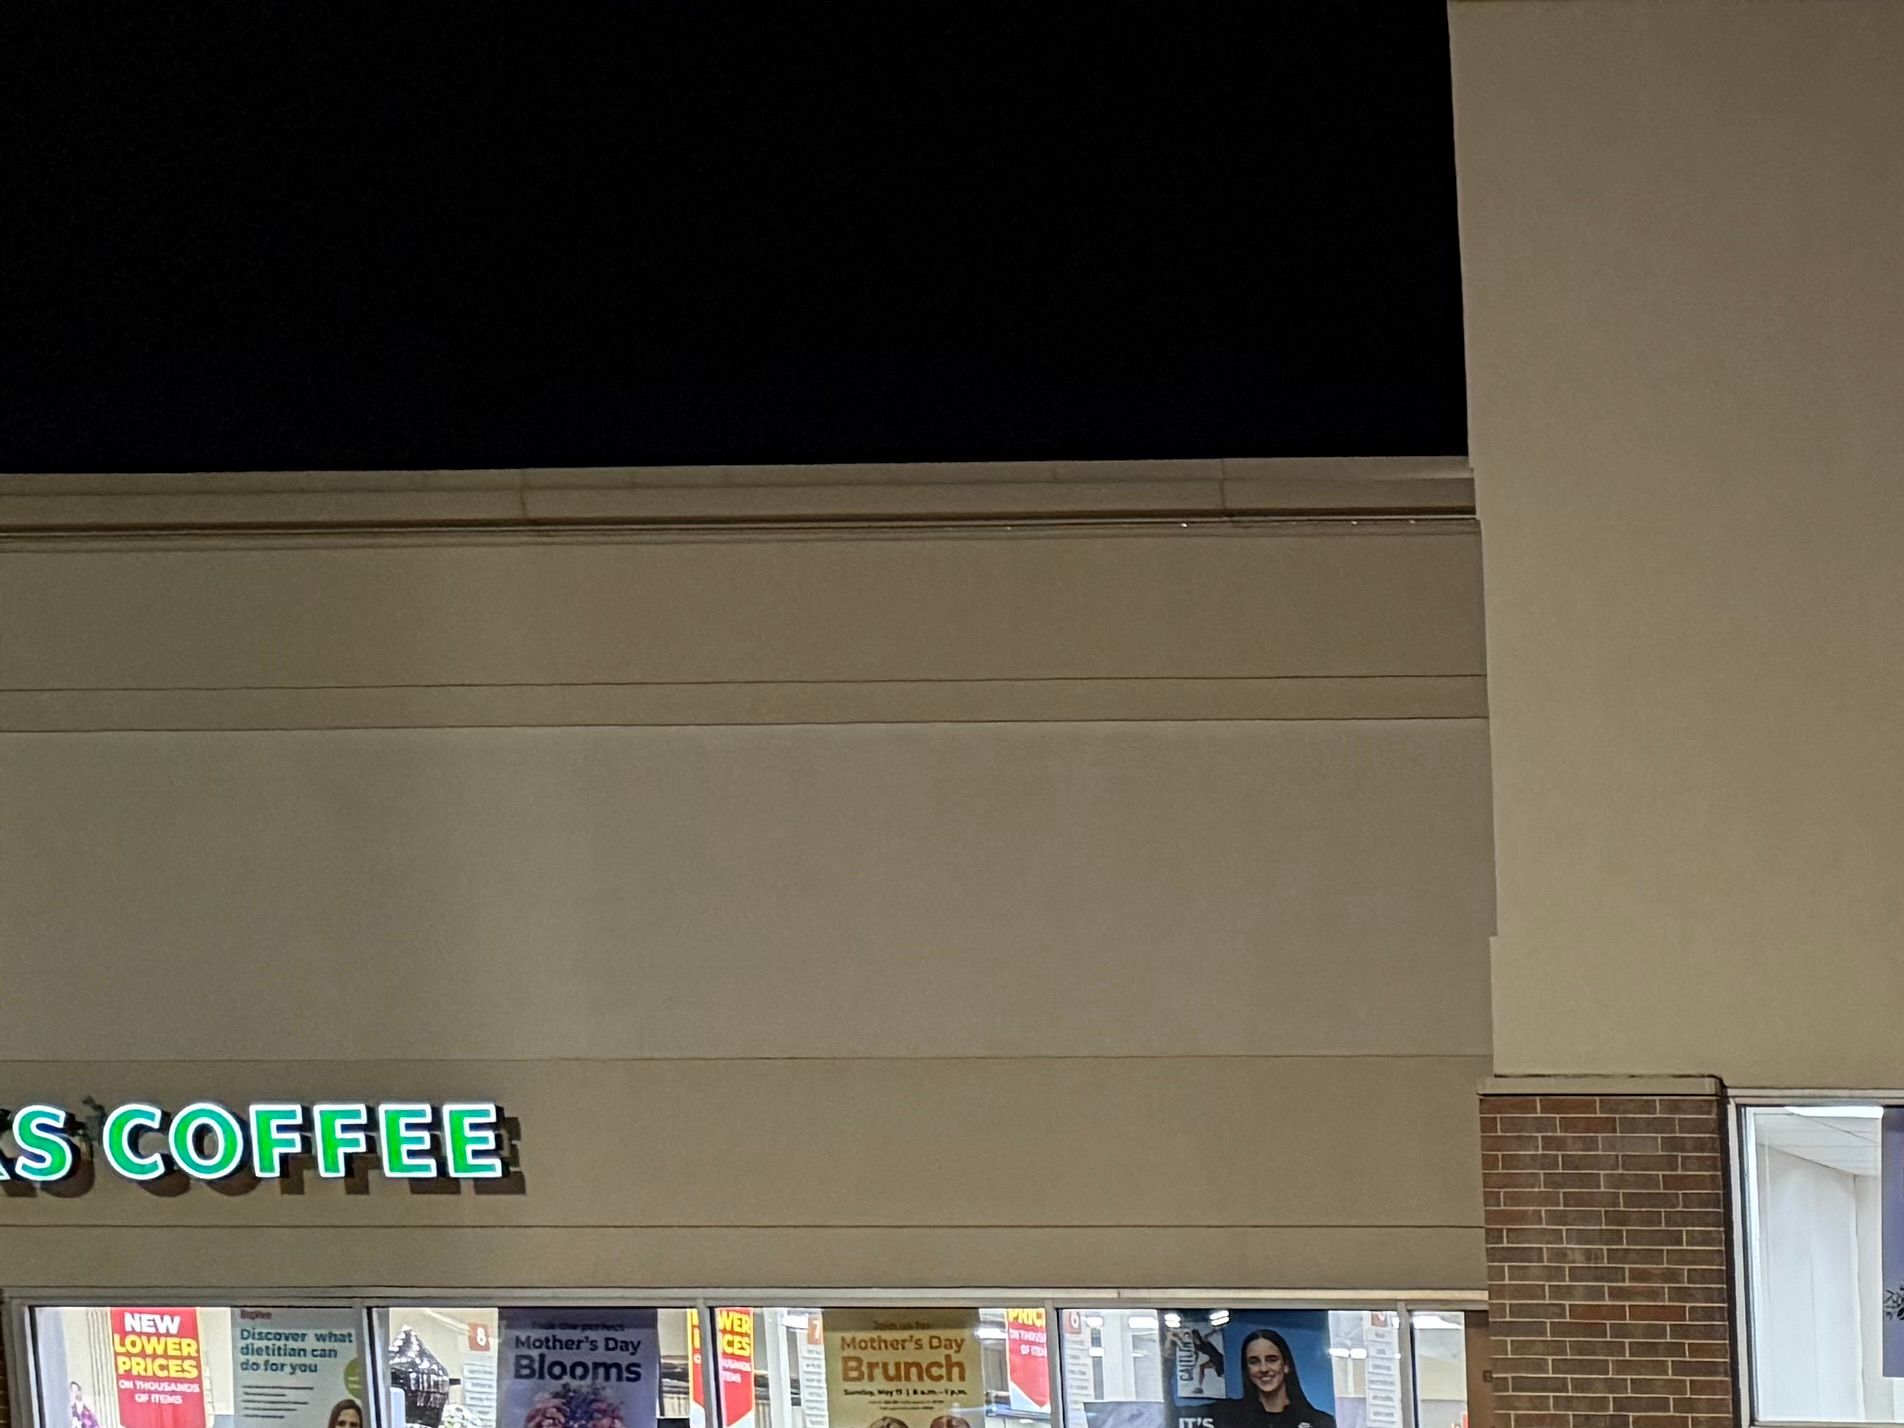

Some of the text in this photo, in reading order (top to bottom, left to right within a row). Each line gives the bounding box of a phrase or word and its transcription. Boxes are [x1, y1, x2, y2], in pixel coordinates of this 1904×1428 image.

[0, 1103, 502, 1181] S COFFEE
[124, 1312, 181, 1334] NEW
[113, 1334, 198, 1357] LOWER
[240, 1328, 353, 1343] Discover what
[515, 1334, 642, 1355] Mother's Day
[840, 1334, 966, 1353] Mother's Day
[240, 1343, 338, 1358] dietitian can
[117, 1356, 199, 1379] PRICES
[240, 1359, 318, 1375] do for you
[513, 1352, 643, 1383] Blooms
[841, 1353, 967, 1382] Brunch
[135, 1379, 200, 1393] THOUSANDS
[151, 1393, 183, 1405] ITEMS
